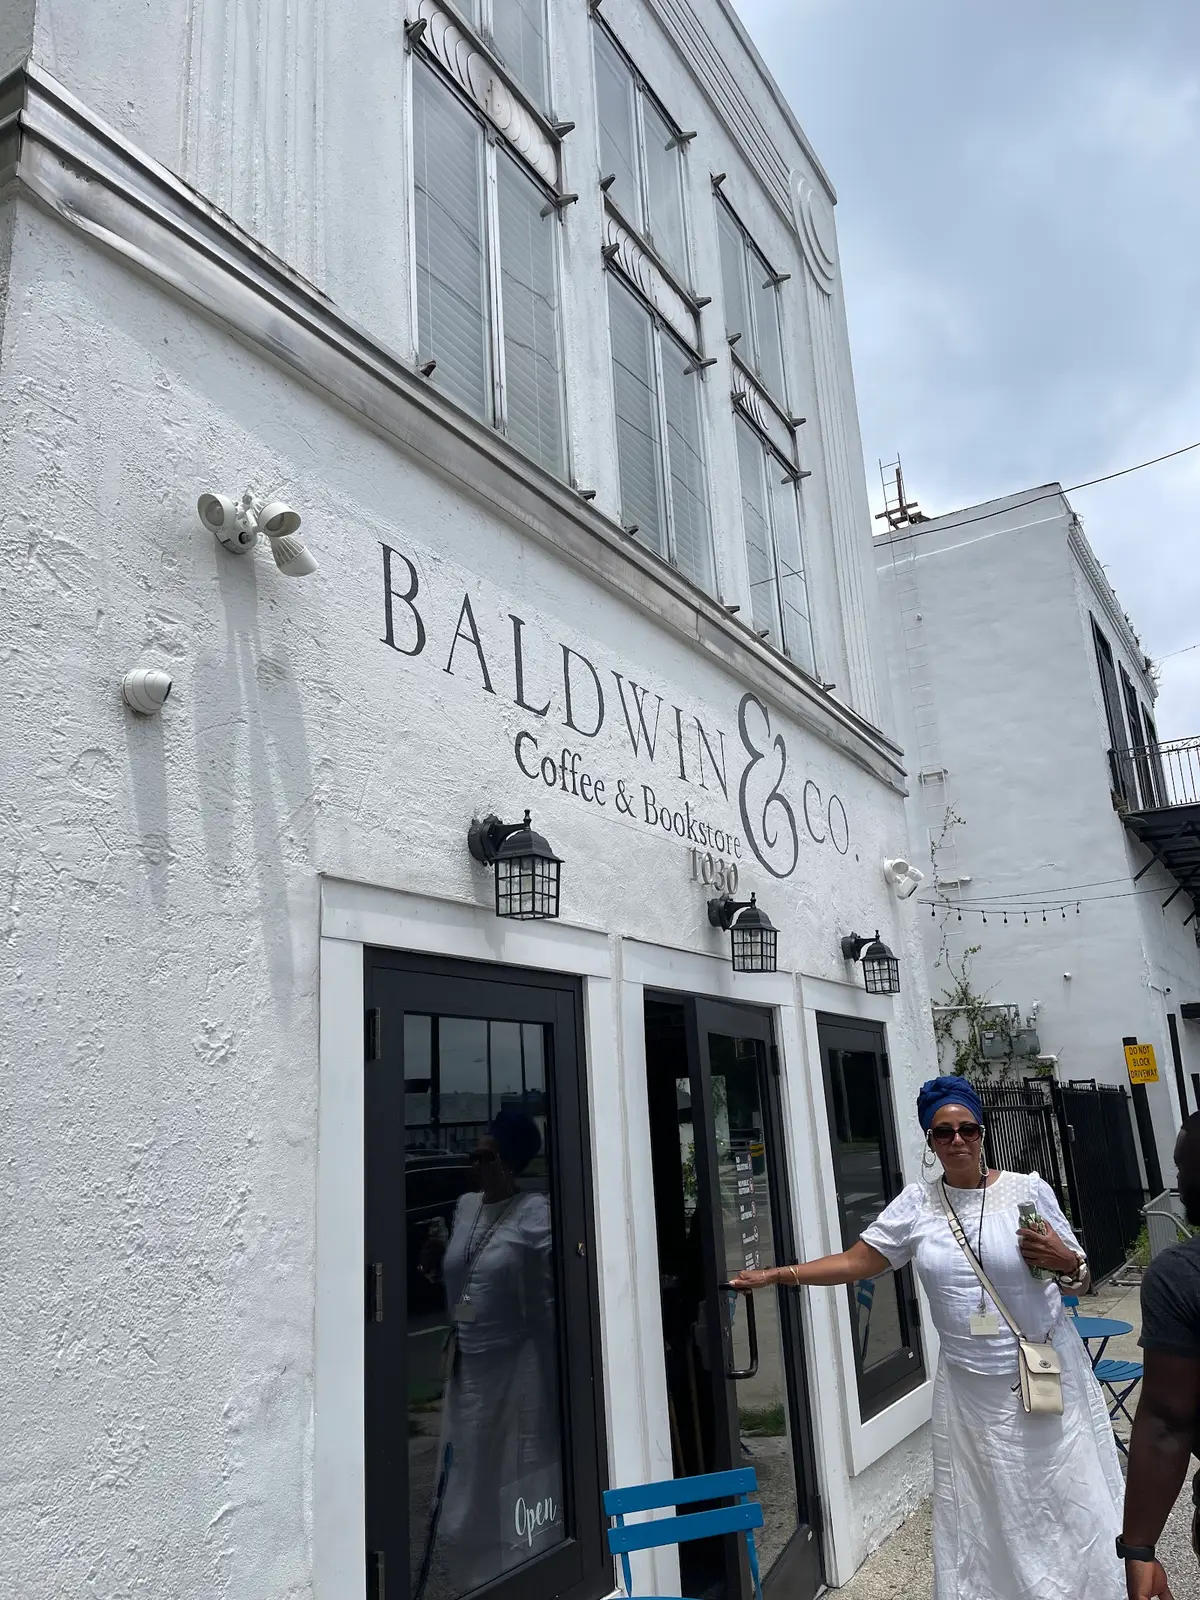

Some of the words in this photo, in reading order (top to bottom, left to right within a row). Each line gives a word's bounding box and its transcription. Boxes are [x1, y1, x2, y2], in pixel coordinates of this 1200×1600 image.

[377, 541, 729, 802] BALDWIN
[737, 692, 799, 879] &
[803, 779, 859, 862] CO.
[514, 730, 606, 806] Coffee
[615, 779, 637, 819] &
[640, 784, 742, 859] Bookstore
[689, 846, 739, 894] 1030
[1128, 1046, 1137, 1055] DO
[1138, 1045, 1150, 1055] NOT
[1130, 1068, 1157, 1079] DRIVEWAY
[1132, 1057, 1151, 1067] BLOCK
[514, 1496, 557, 1547] Open
